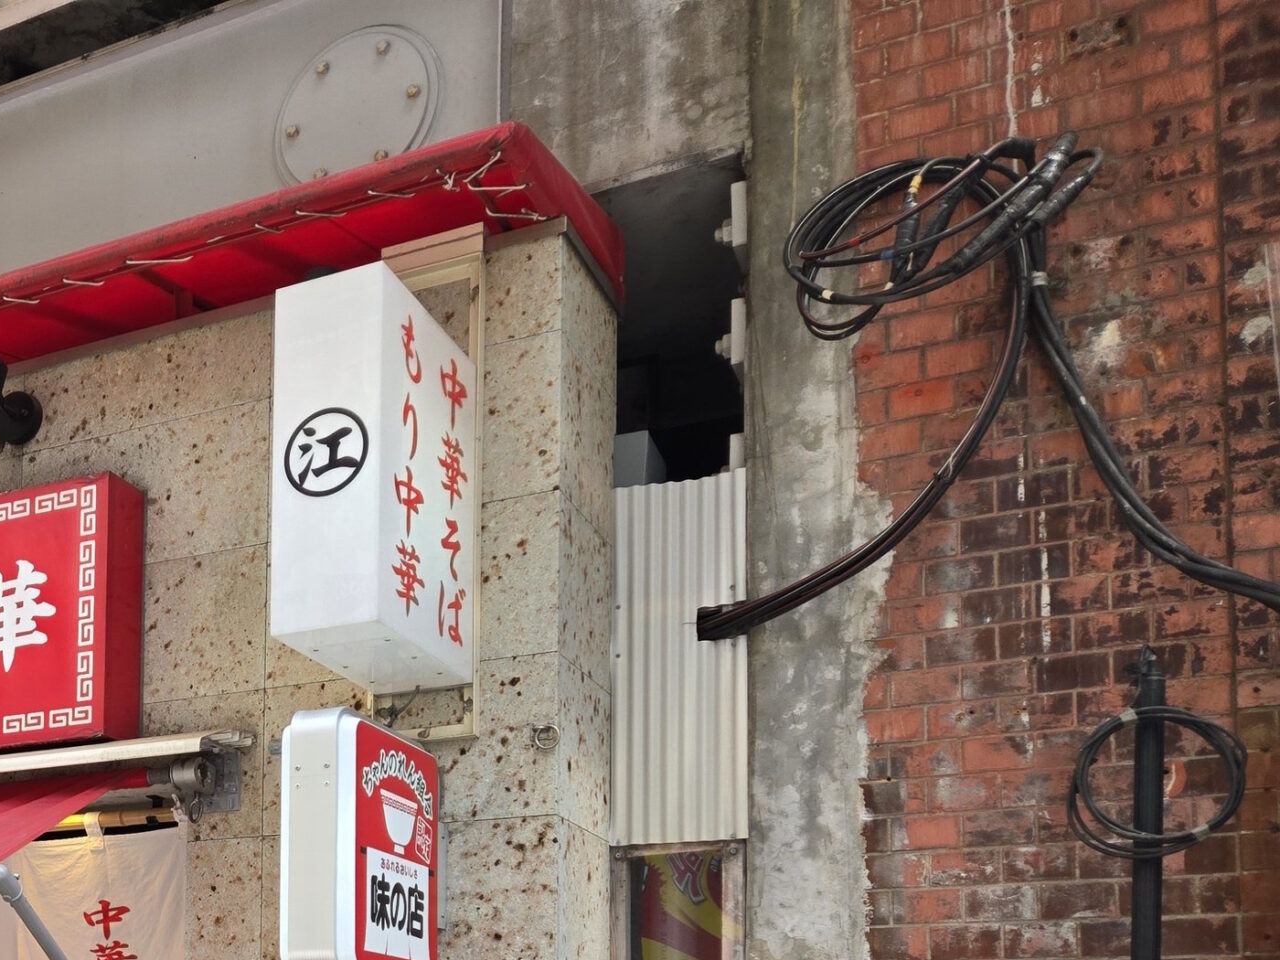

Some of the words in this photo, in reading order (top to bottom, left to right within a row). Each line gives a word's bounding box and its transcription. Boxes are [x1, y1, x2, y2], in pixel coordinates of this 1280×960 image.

[392, 314, 425, 617] もり中華
[438, 357, 469, 648] 中華そば
[370, 873, 425, 940] 味の店
